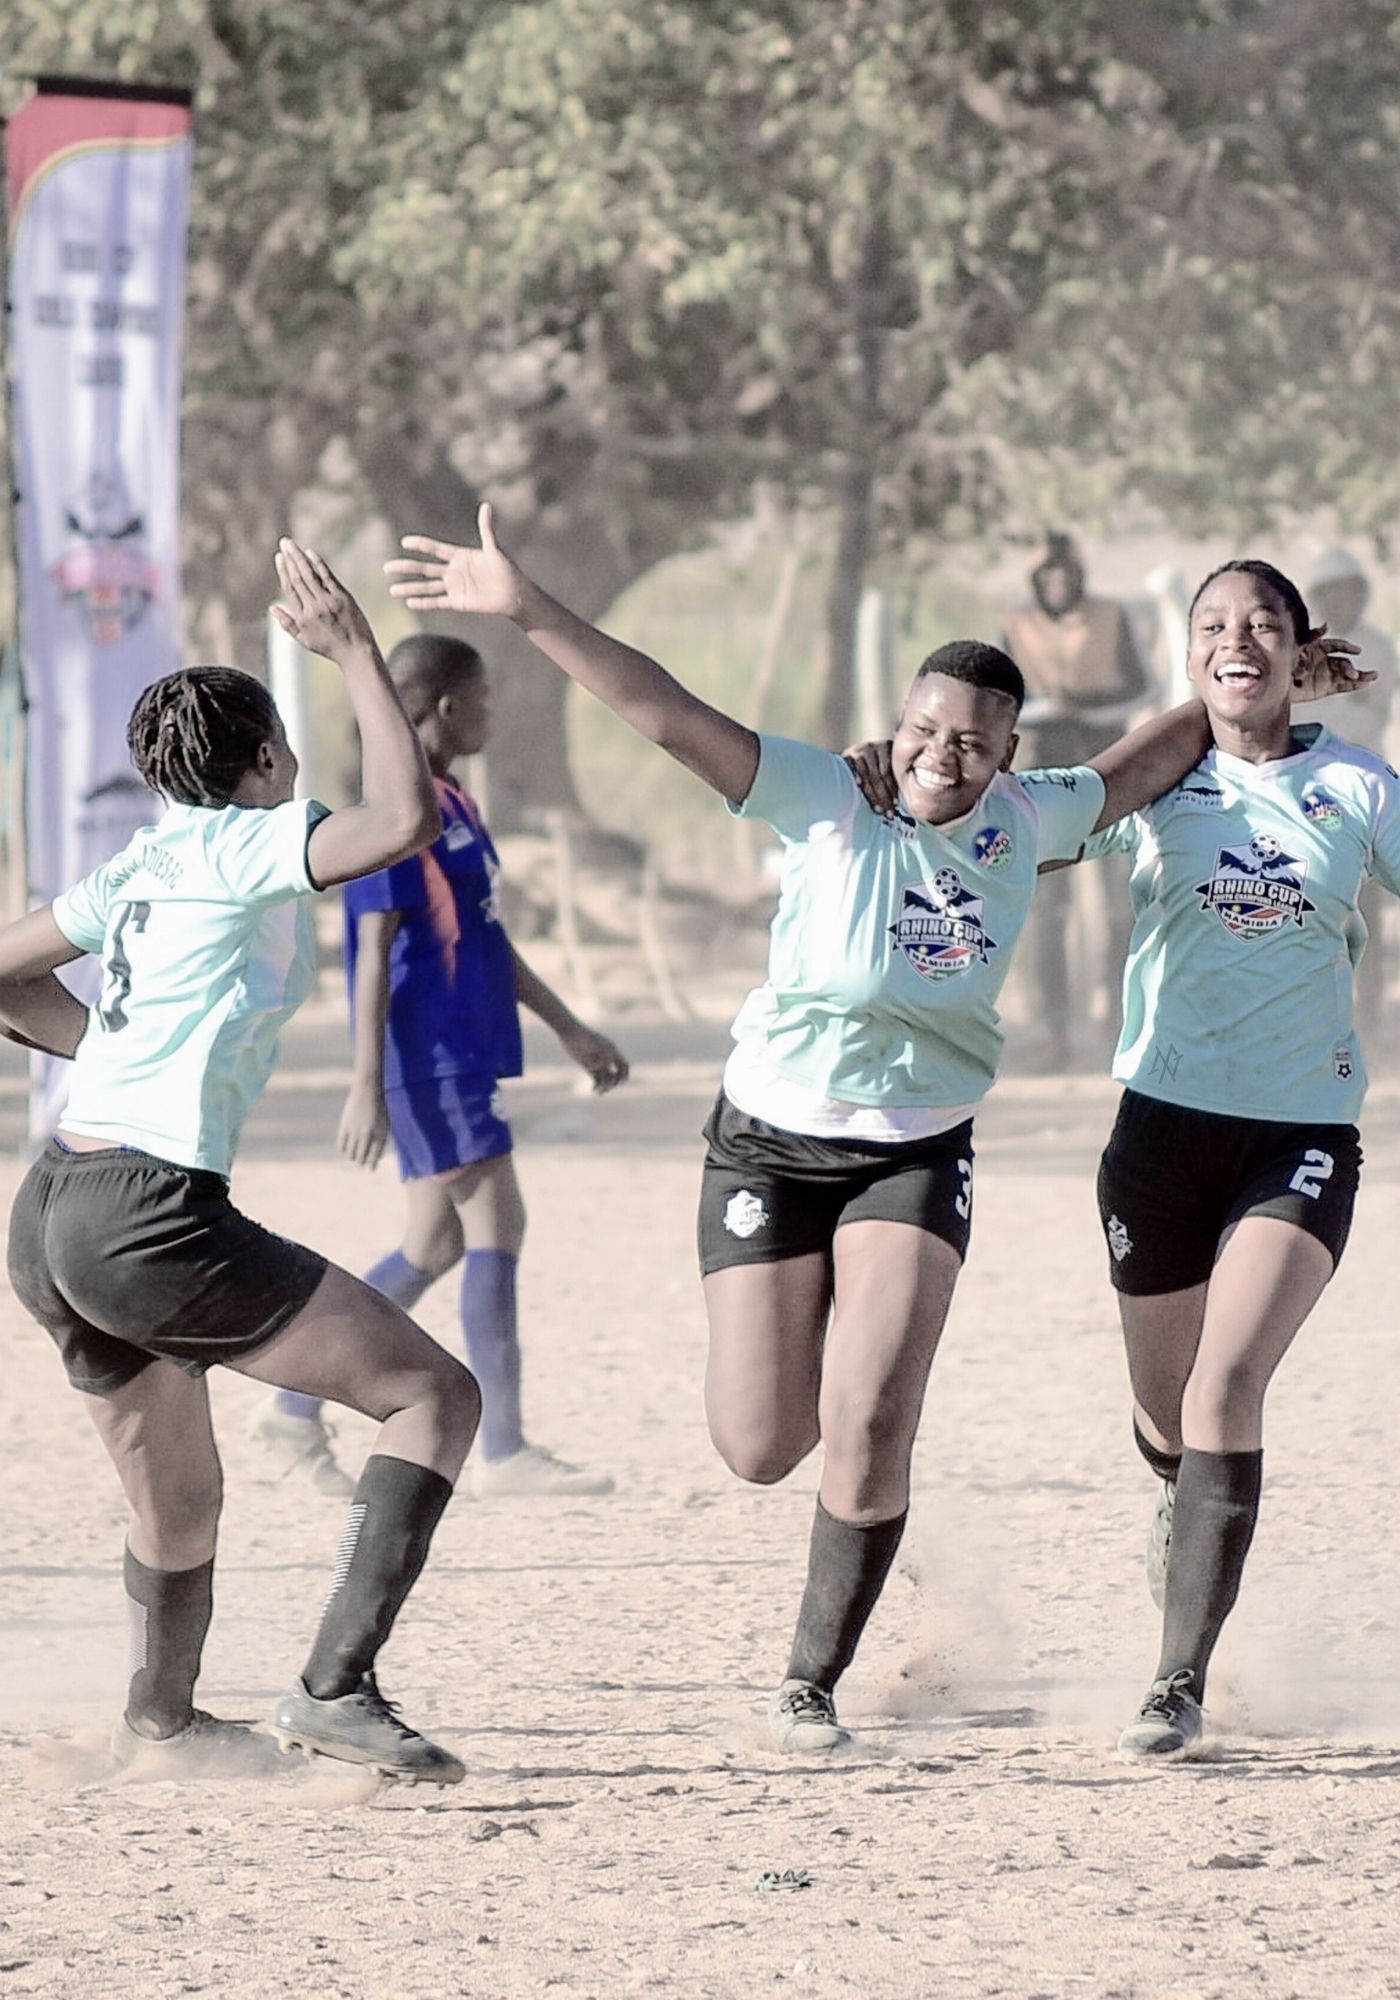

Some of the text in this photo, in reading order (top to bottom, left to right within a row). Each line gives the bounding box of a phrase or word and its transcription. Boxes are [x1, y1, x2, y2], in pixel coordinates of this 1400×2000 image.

[1214, 878, 1300, 907] RHINO CUP
[900, 919, 982, 944] RHINO CUP
[1224, 911, 1278, 927] NAMIBIA
[912, 952, 965, 968] NAMIBIA
[1288, 1148, 1335, 1200] 2
[955, 1158, 973, 1221] 3
